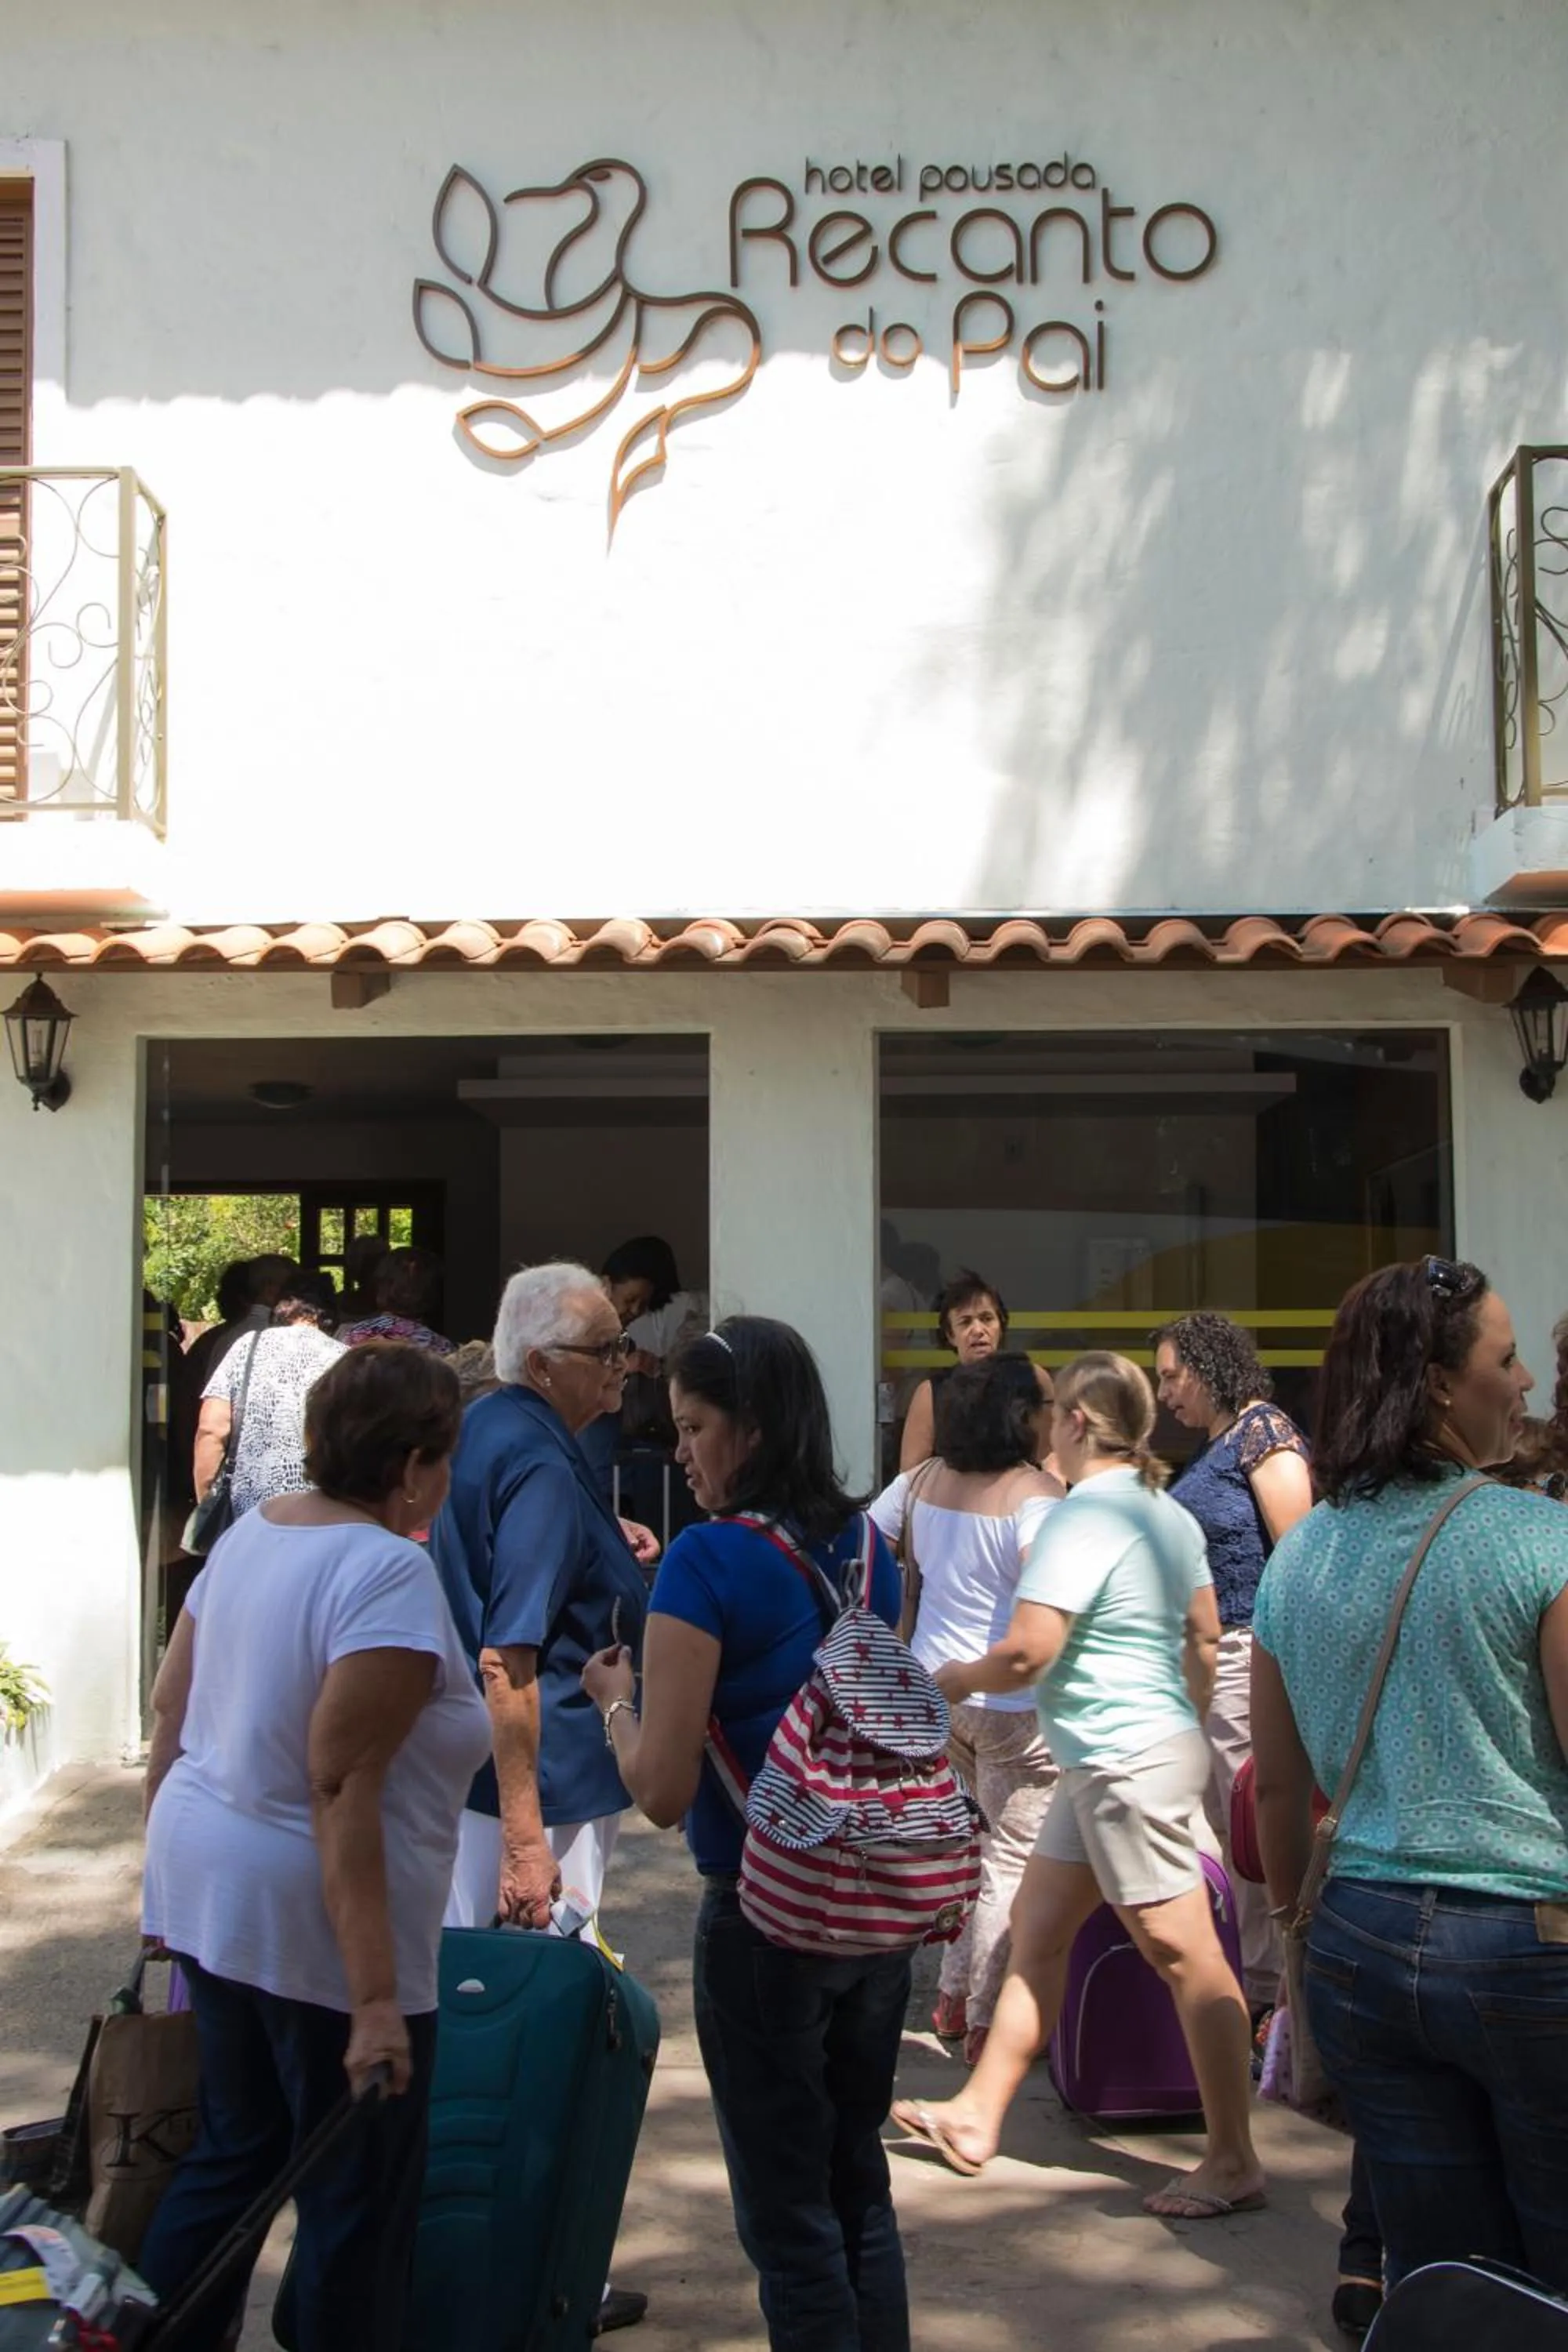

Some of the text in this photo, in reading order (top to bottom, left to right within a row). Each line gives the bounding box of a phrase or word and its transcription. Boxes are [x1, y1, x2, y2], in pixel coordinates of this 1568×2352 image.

[804, 150, 1096, 202] hotel pousada
[730, 177, 1218, 288] Recanto
[833, 290, 1105, 393] do Pai
